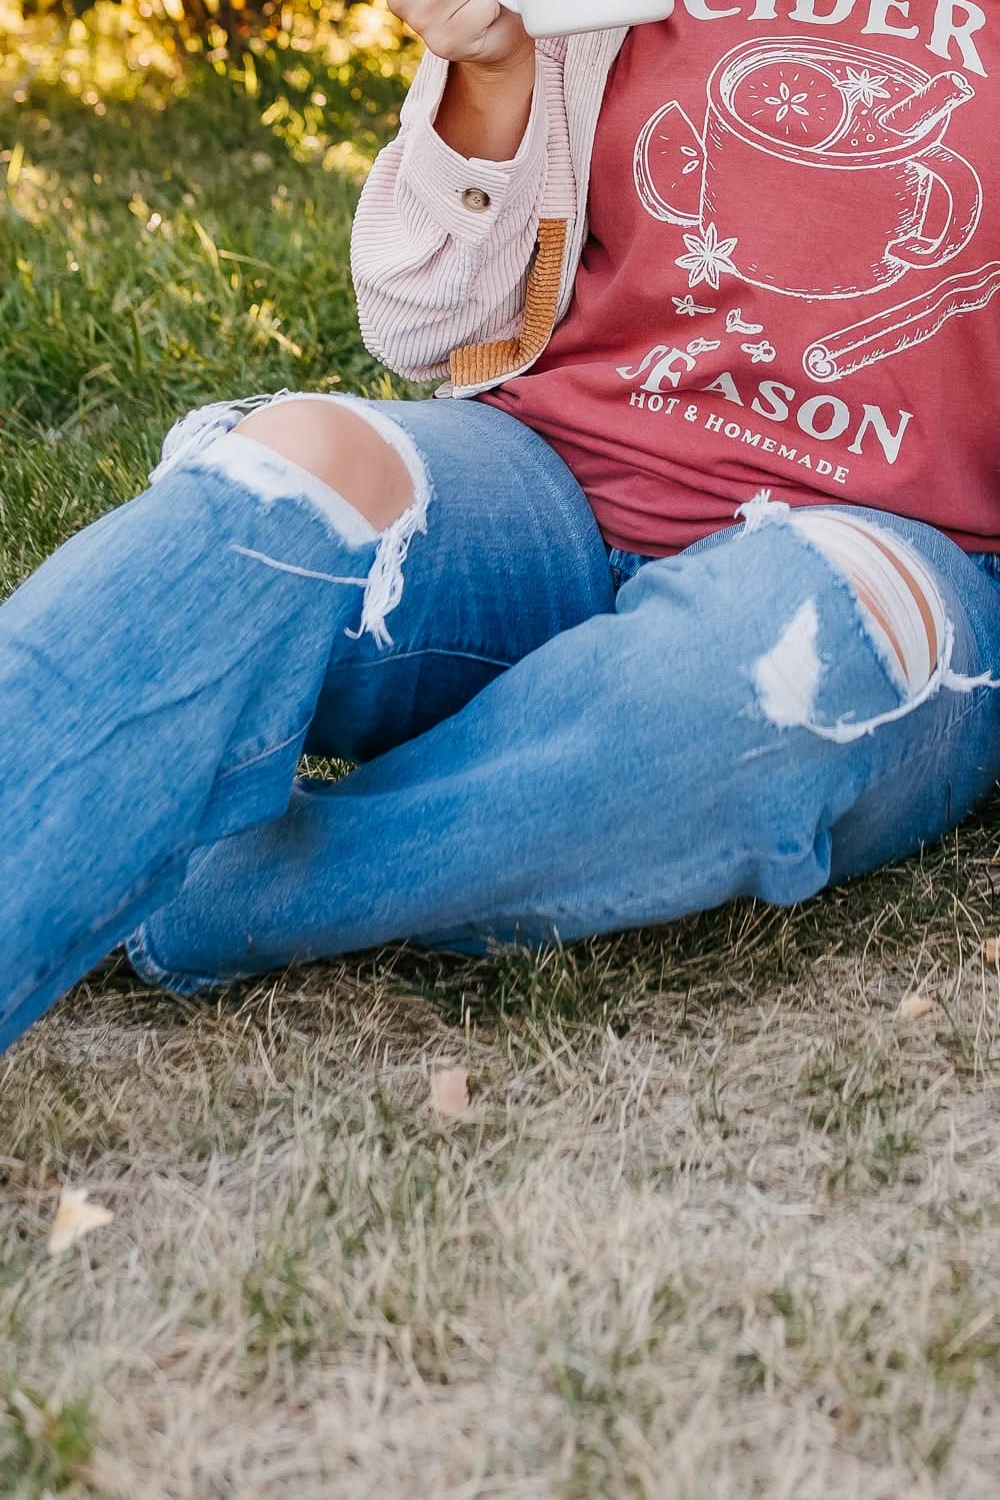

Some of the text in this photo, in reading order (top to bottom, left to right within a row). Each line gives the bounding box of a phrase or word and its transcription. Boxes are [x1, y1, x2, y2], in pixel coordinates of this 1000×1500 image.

[629, 392, 850, 484] HOT & HOMEMADE
